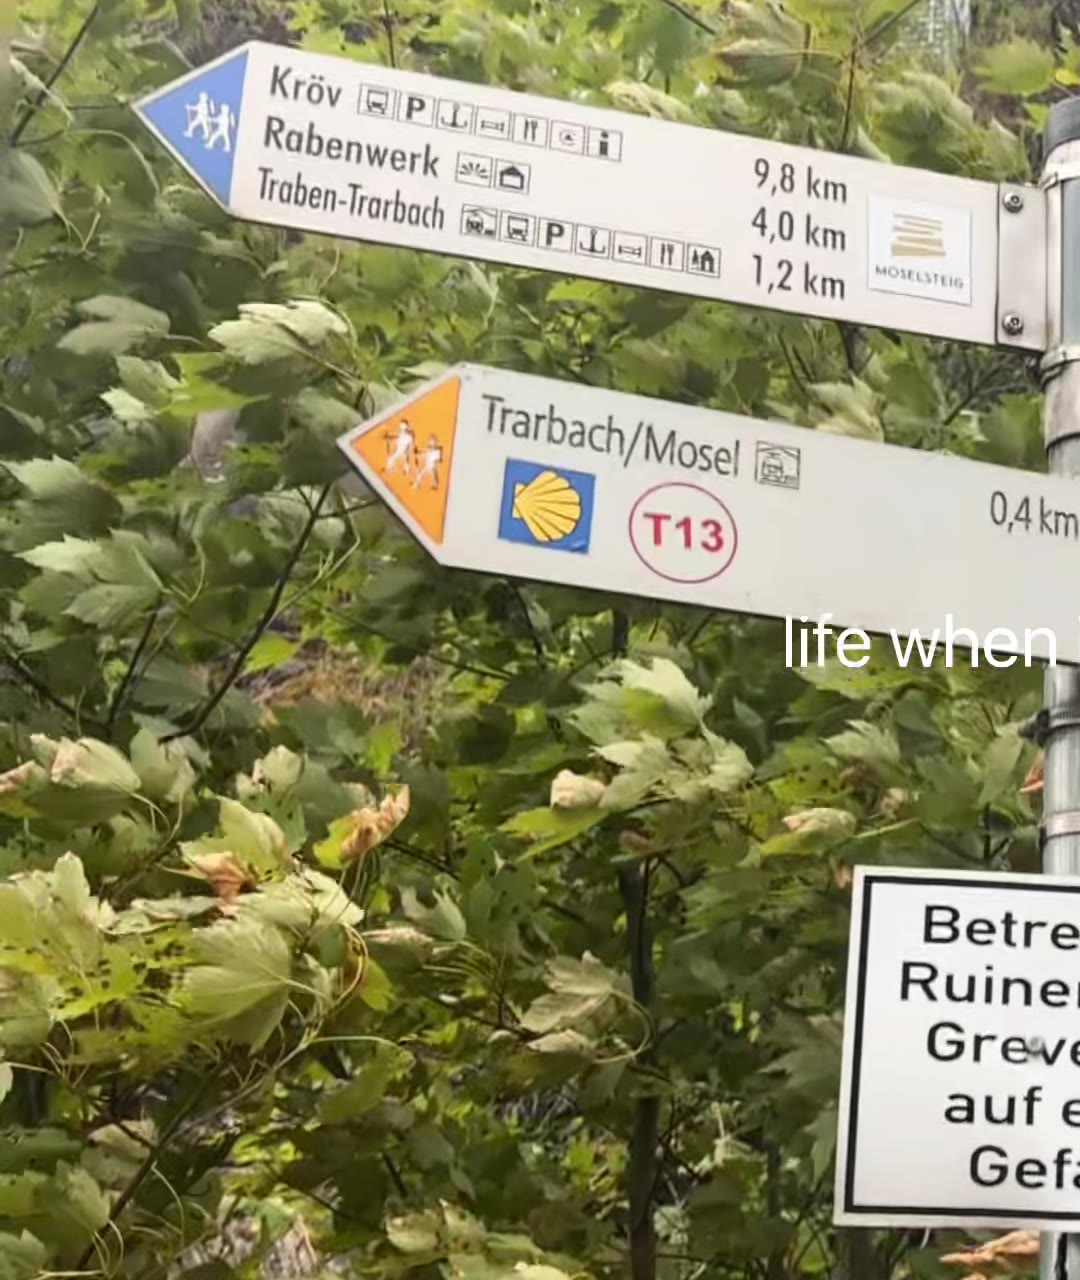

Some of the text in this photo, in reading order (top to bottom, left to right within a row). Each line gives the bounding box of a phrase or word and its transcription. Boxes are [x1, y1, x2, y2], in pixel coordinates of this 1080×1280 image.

[263, 115, 846, 251] Rabenwerk 4,0 km
[270, 65, 847, 203] Kröv 9,8 km
[258, 167, 845, 300] Traben-Trarbach 1,2 km
[875, 264, 964, 289] MOSELSTEIG
[482, 394, 1080, 540] Trarbach/Mosel 0,4 km
[643, 513, 725, 552] T13
[943, 1086, 1044, 1125] auf
